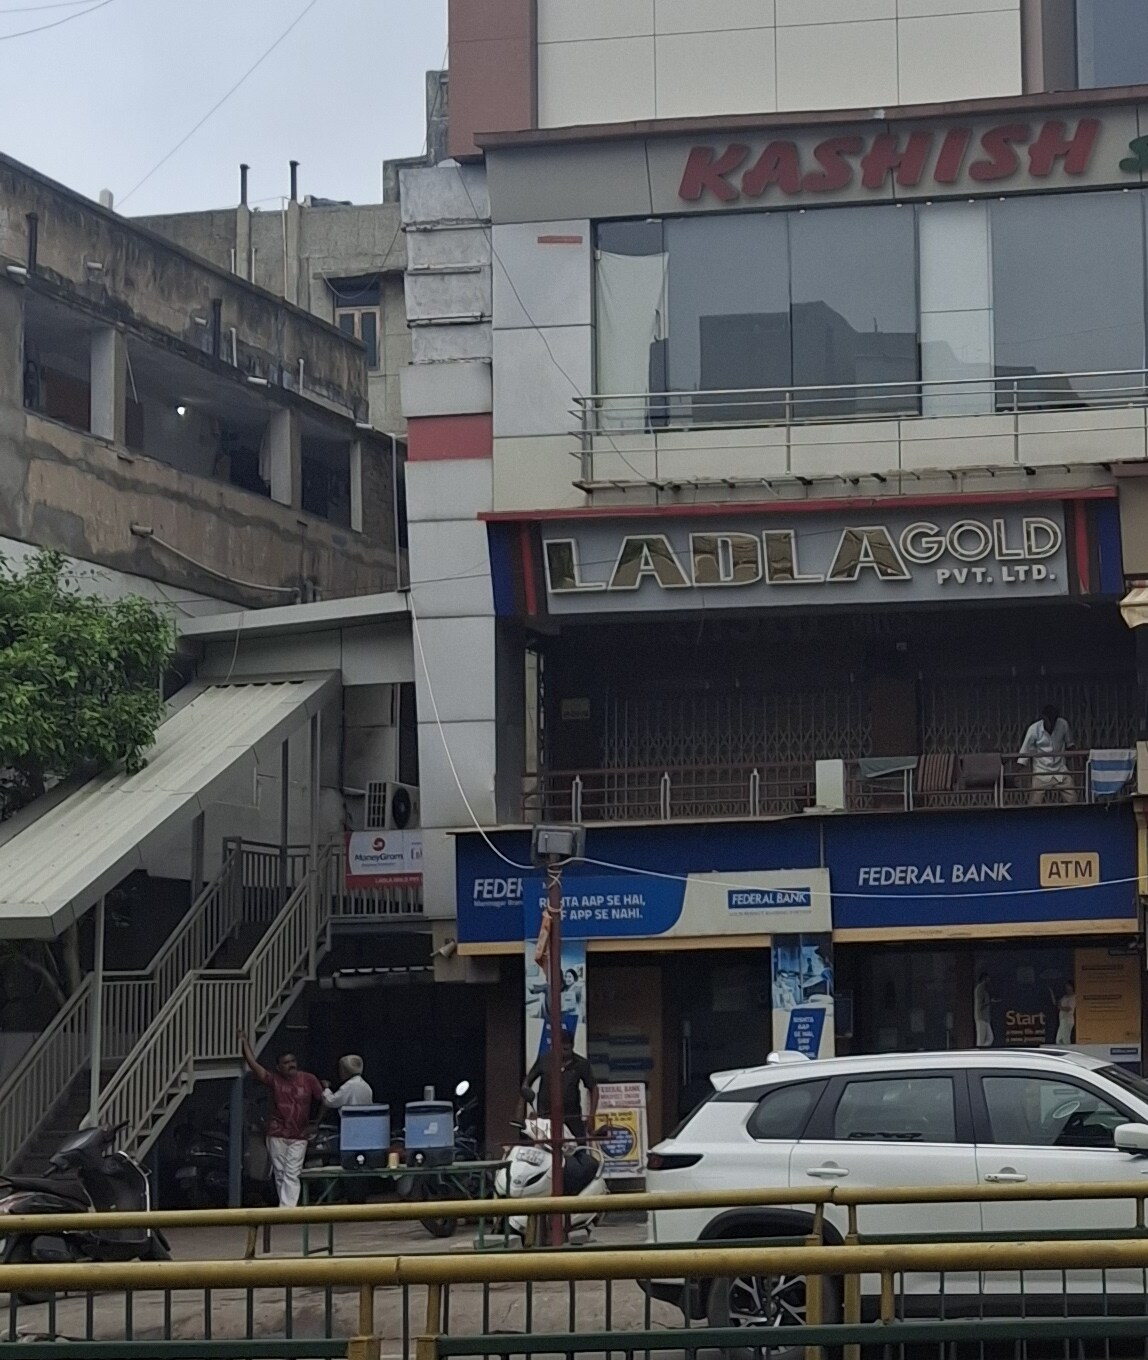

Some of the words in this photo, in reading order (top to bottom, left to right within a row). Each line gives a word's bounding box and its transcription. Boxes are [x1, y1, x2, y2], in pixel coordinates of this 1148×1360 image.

[678, 118, 1101, 202] KASHISH
[544, 526, 912, 595] LADLA
[900, 516, 1062, 564] GOLD
[937, 566, 995, 585] PVT.
[1002, 563, 1058, 583] LTD.
[354, 853, 404, 861] MoneyGram
[859, 866, 945, 887] FEDERAL
[951, 862, 1013, 883] BANK
[1047, 860, 1093, 880] ATM
[582, 895, 604, 907] AAP
[608, 894, 621, 906] SE
[731, 892, 775, 905] FEDERAL
[776, 891, 807, 904] BANK
[570, 909, 592, 920] APP
[595, 909, 609, 920] SE
[612, 908, 643, 919] NAHI.
[1006, 1010, 1046, 1027] Start
